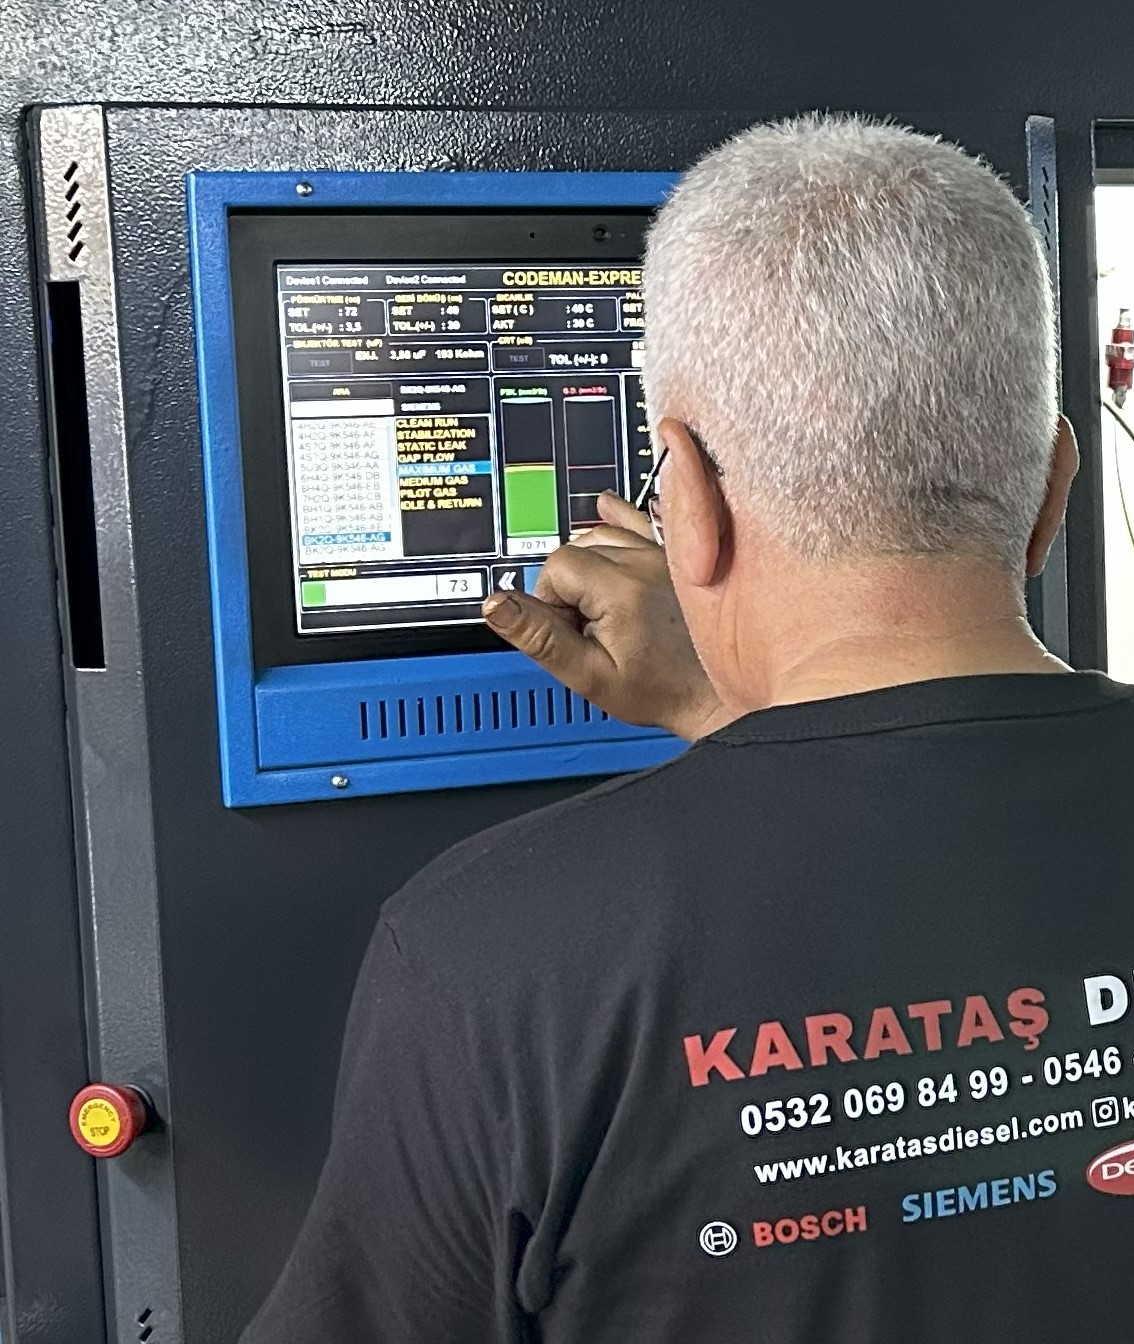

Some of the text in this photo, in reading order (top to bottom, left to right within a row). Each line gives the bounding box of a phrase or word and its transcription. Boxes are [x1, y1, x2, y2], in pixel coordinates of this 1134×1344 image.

[502, 270, 645, 285] CODEMAN-EXPRE
[287, 306, 310, 317] SET
[391, 305, 413, 316] SET
[309, 359, 330, 367] TEST
[509, 354, 529, 363] TEST
[396, 417, 459, 428] CLEAN RUN
[397, 429, 476, 440] STABILIZATION
[397, 440, 467, 452] STATIC LEAK
[397, 452, 455, 463] GAP FLOW
[399, 463, 477, 475] MAXIMUM GAS
[400, 475, 469, 487] MEDIUM GAS
[400, 487, 457, 498] PILOT GAS
[400, 497, 483, 510] IDLE & RETURN
[521, 540, 547, 550] 70 71
[307, 569, 330, 579] TEST
[449, 579, 469, 593] 73
[683, 987, 1049, 1087] KARATAŞ
[740, 1093, 831, 1136] 0532
[843, 1081, 905, 1118] 069
[917, 1073, 957, 1107] 84
[968, 1066, 1008, 1099] 99
[1021, 1074, 1033, 1085] -
[1043, 1046, 1122, 1086] 0546
[82, 1102, 116, 1126] EMERGENCY
[90, 1126, 110, 1137] STOP
[753, 1108, 1083, 1183] www.karatasdiesel.com
[752, 1206, 868, 1248] BOSCH
[902, 1169, 1058, 1223] SIEMENS
